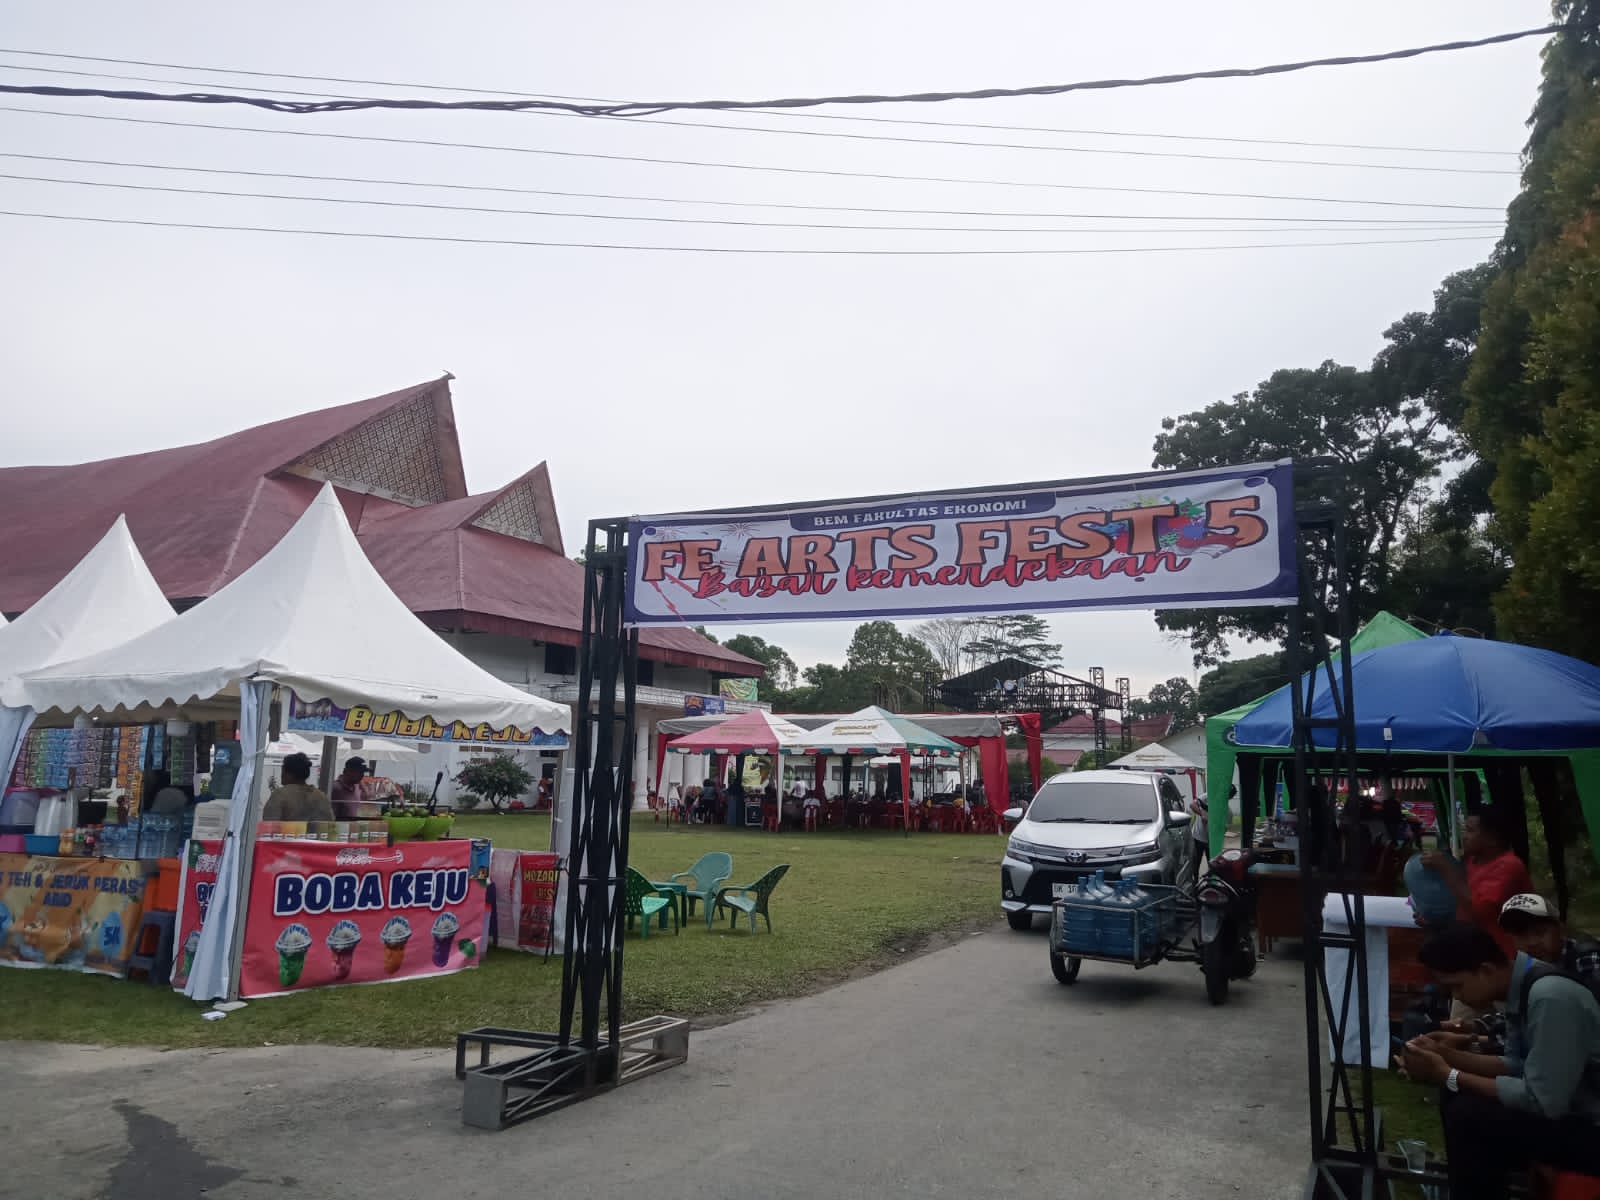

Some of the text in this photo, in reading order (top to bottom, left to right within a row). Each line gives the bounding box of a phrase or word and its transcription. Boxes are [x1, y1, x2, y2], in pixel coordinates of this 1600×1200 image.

[813, 499, 1027, 527] BEM FAKULTAS EKONOMI
[642, 496, 1268, 582] FE ARTS FEST 5
[274, 868, 469, 916] BOBA KEJU
